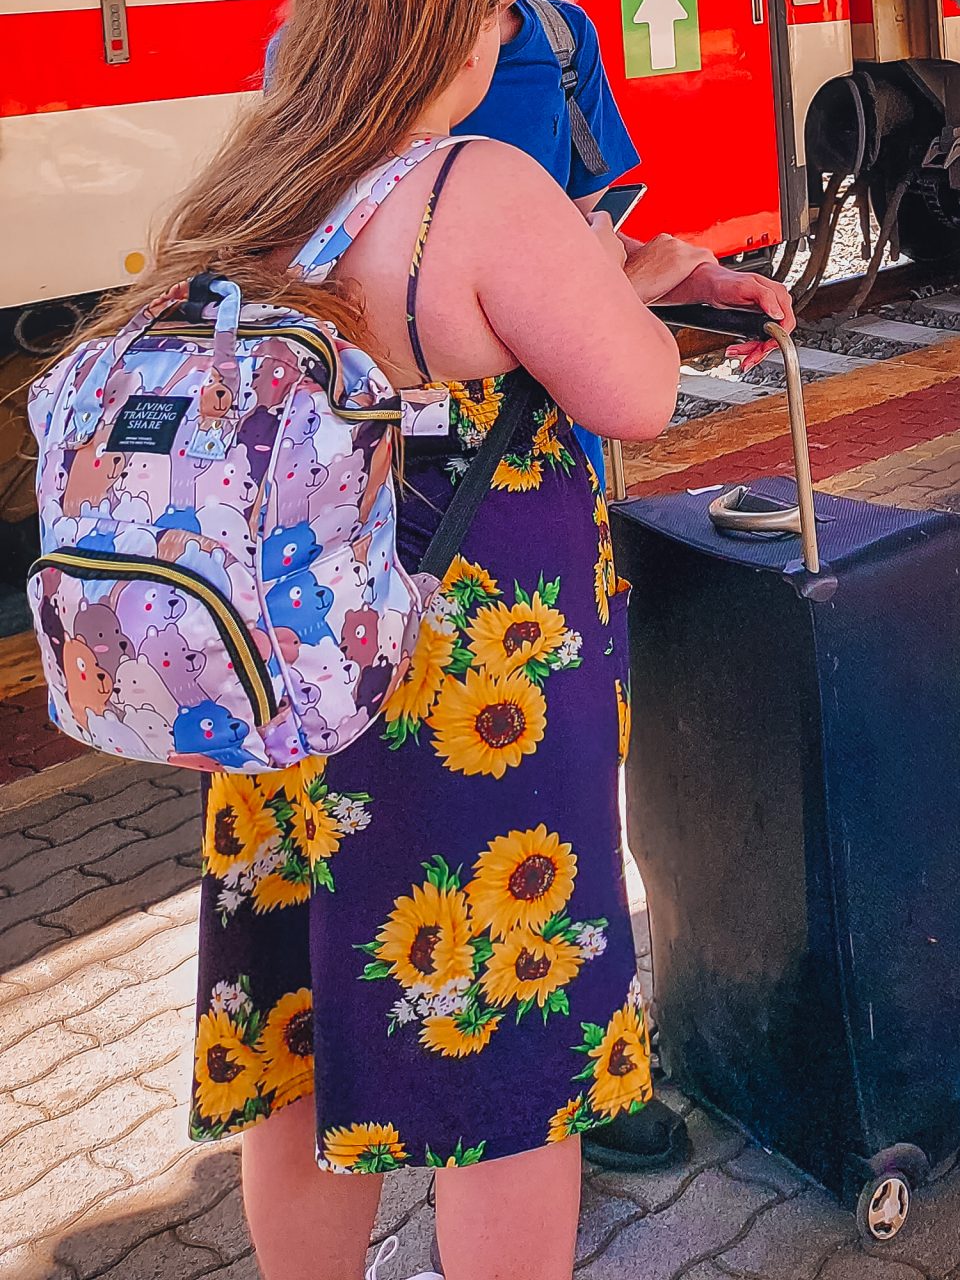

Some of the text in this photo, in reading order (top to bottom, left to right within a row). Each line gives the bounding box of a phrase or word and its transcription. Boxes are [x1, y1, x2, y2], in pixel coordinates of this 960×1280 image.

[136, 402, 174, 412] LIVING
[123, 411, 177, 420] TRAVELING
[127, 420, 162, 429] SHARE
